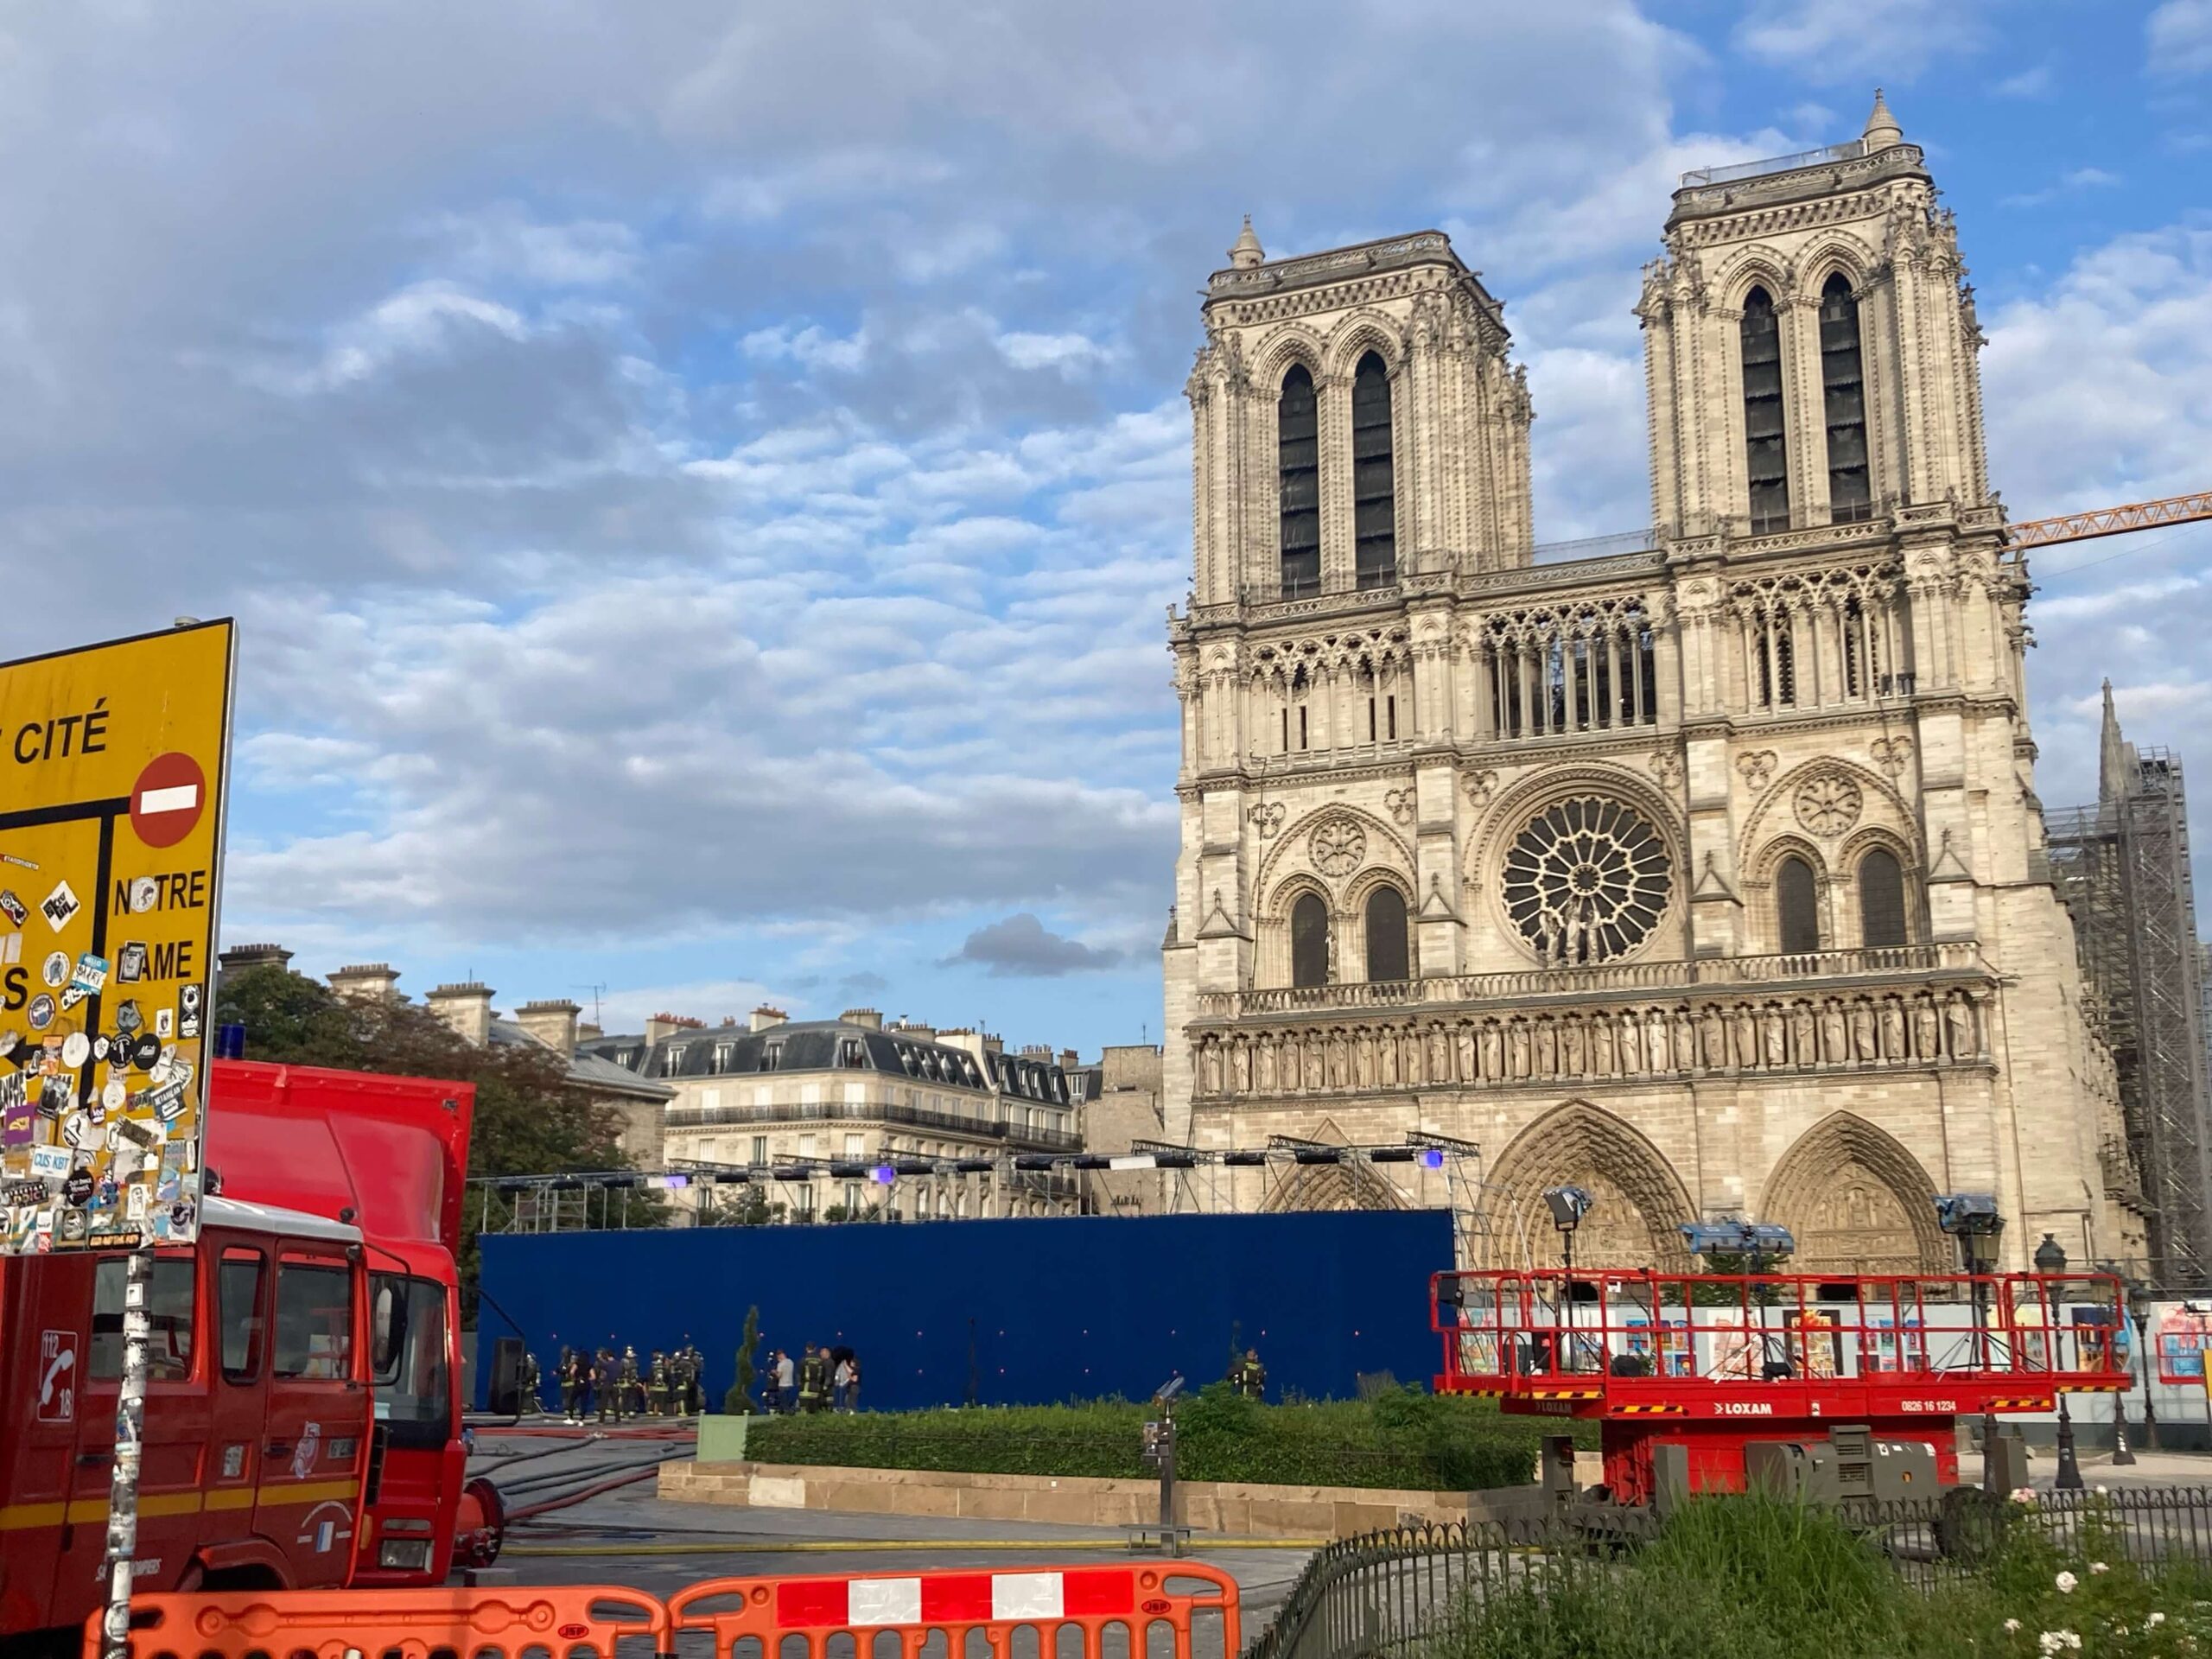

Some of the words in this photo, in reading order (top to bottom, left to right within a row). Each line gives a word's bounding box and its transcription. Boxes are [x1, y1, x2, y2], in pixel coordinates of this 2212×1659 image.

[14, 696, 110, 765] CITÉ
[114, 869, 207, 916] NTRE
[43, 1333, 59, 1358] 112
[60, 1388, 72, 1417] 18
[1541, 1402, 1572, 1414] LOXAM
[1726, 1402, 1772, 1415] LOXAM
[1902, 1401, 1923, 1412] 0826
[1924, 1401, 1935, 1412] 16
[1936, 1401, 1956, 1412] 1234
